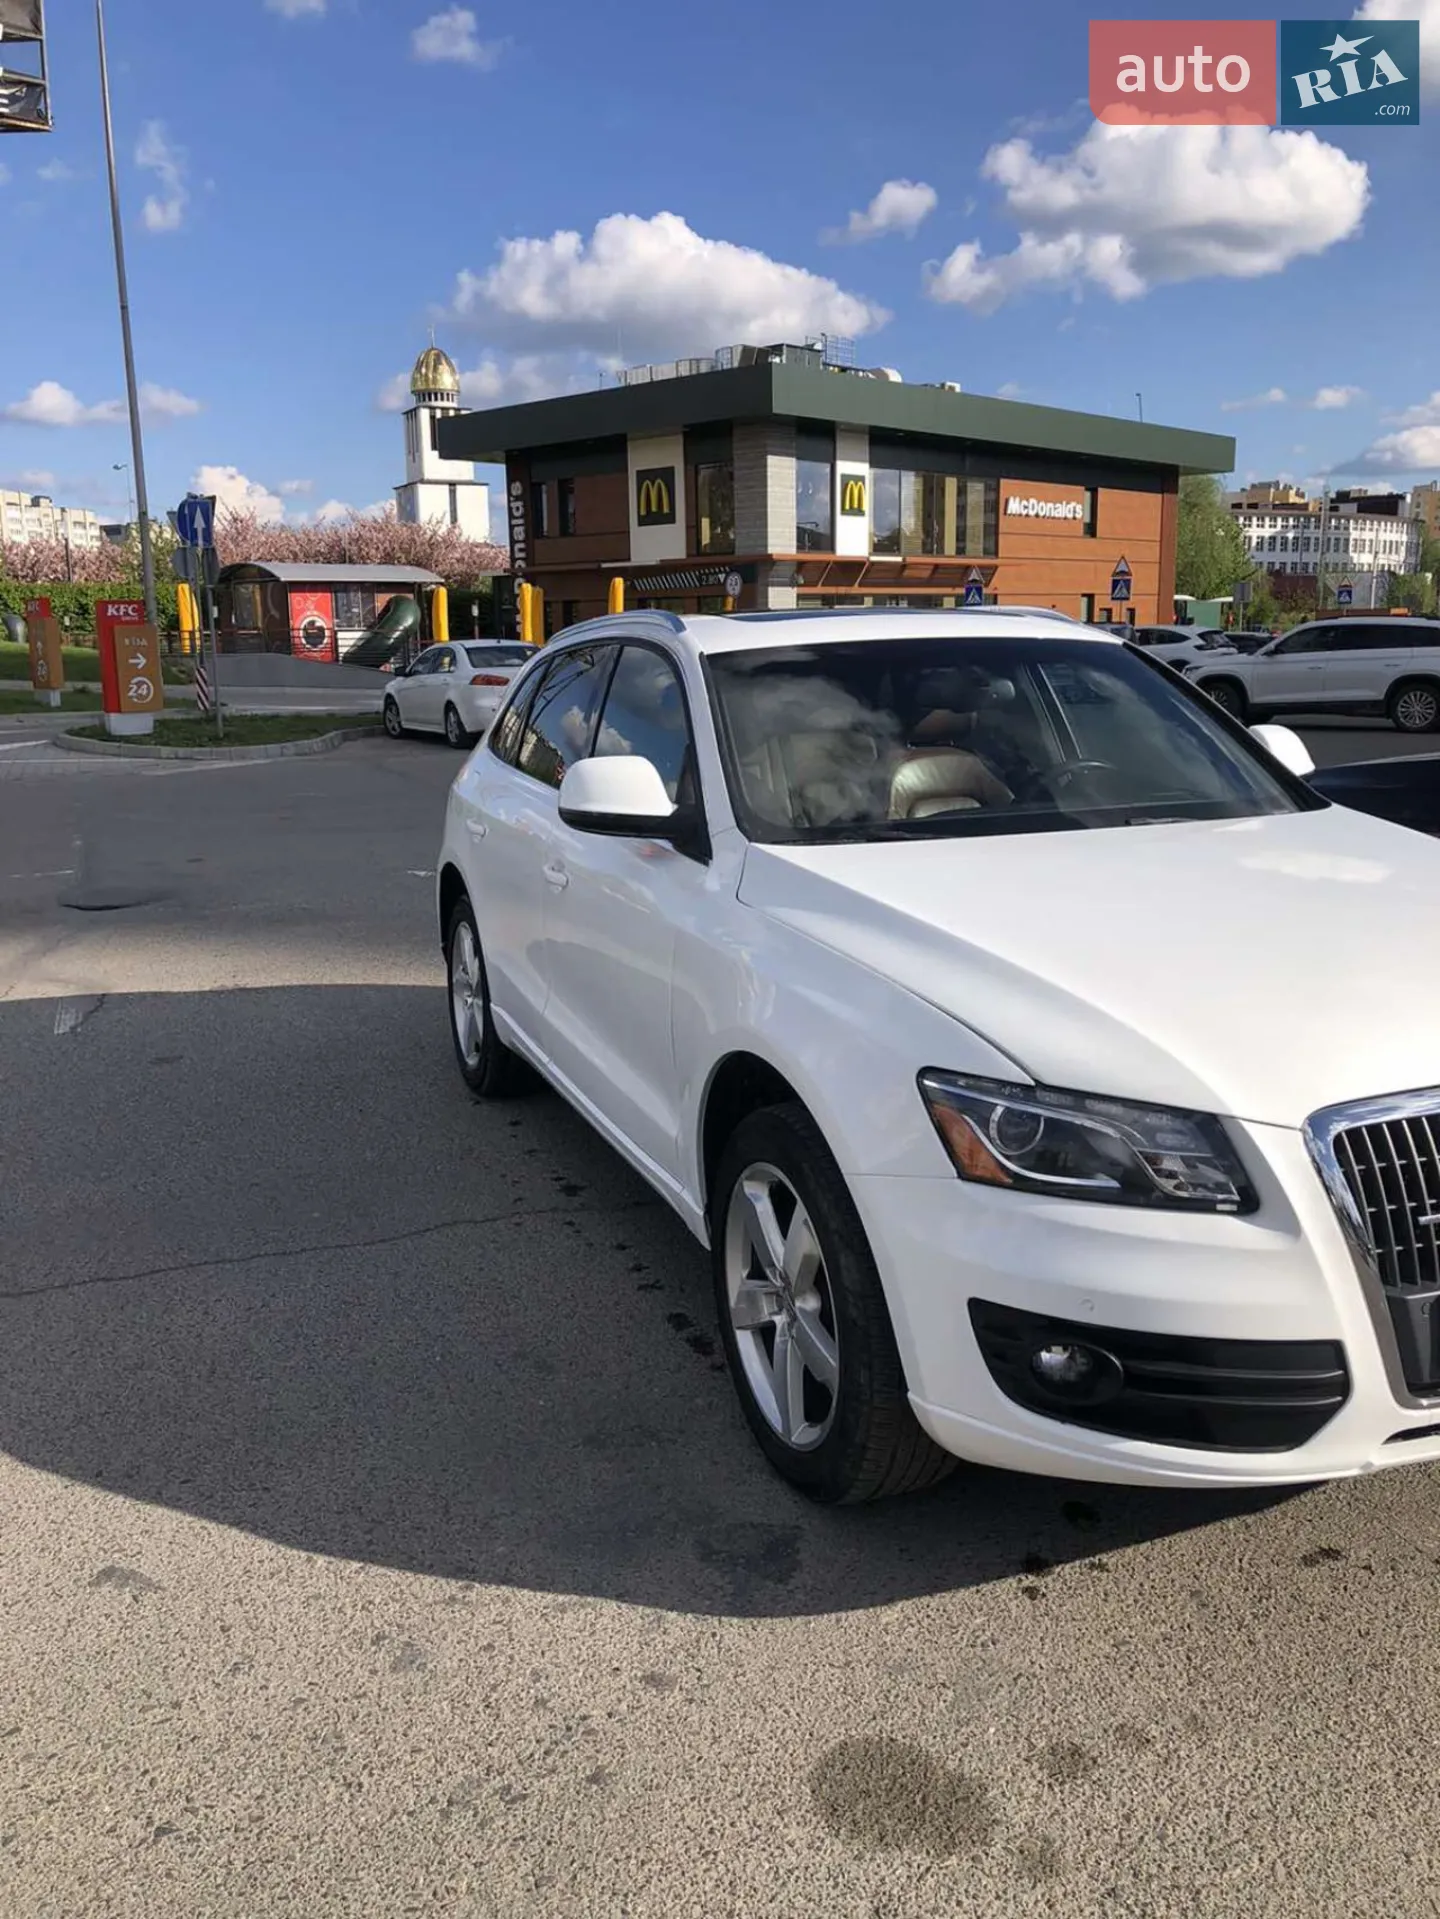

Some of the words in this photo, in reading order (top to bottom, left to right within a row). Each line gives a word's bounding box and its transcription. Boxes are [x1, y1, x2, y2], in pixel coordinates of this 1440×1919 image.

[1006, 495, 1084, 519] McDonald's
[107, 604, 138, 616] KFC
[128, 684, 148, 696] 24
